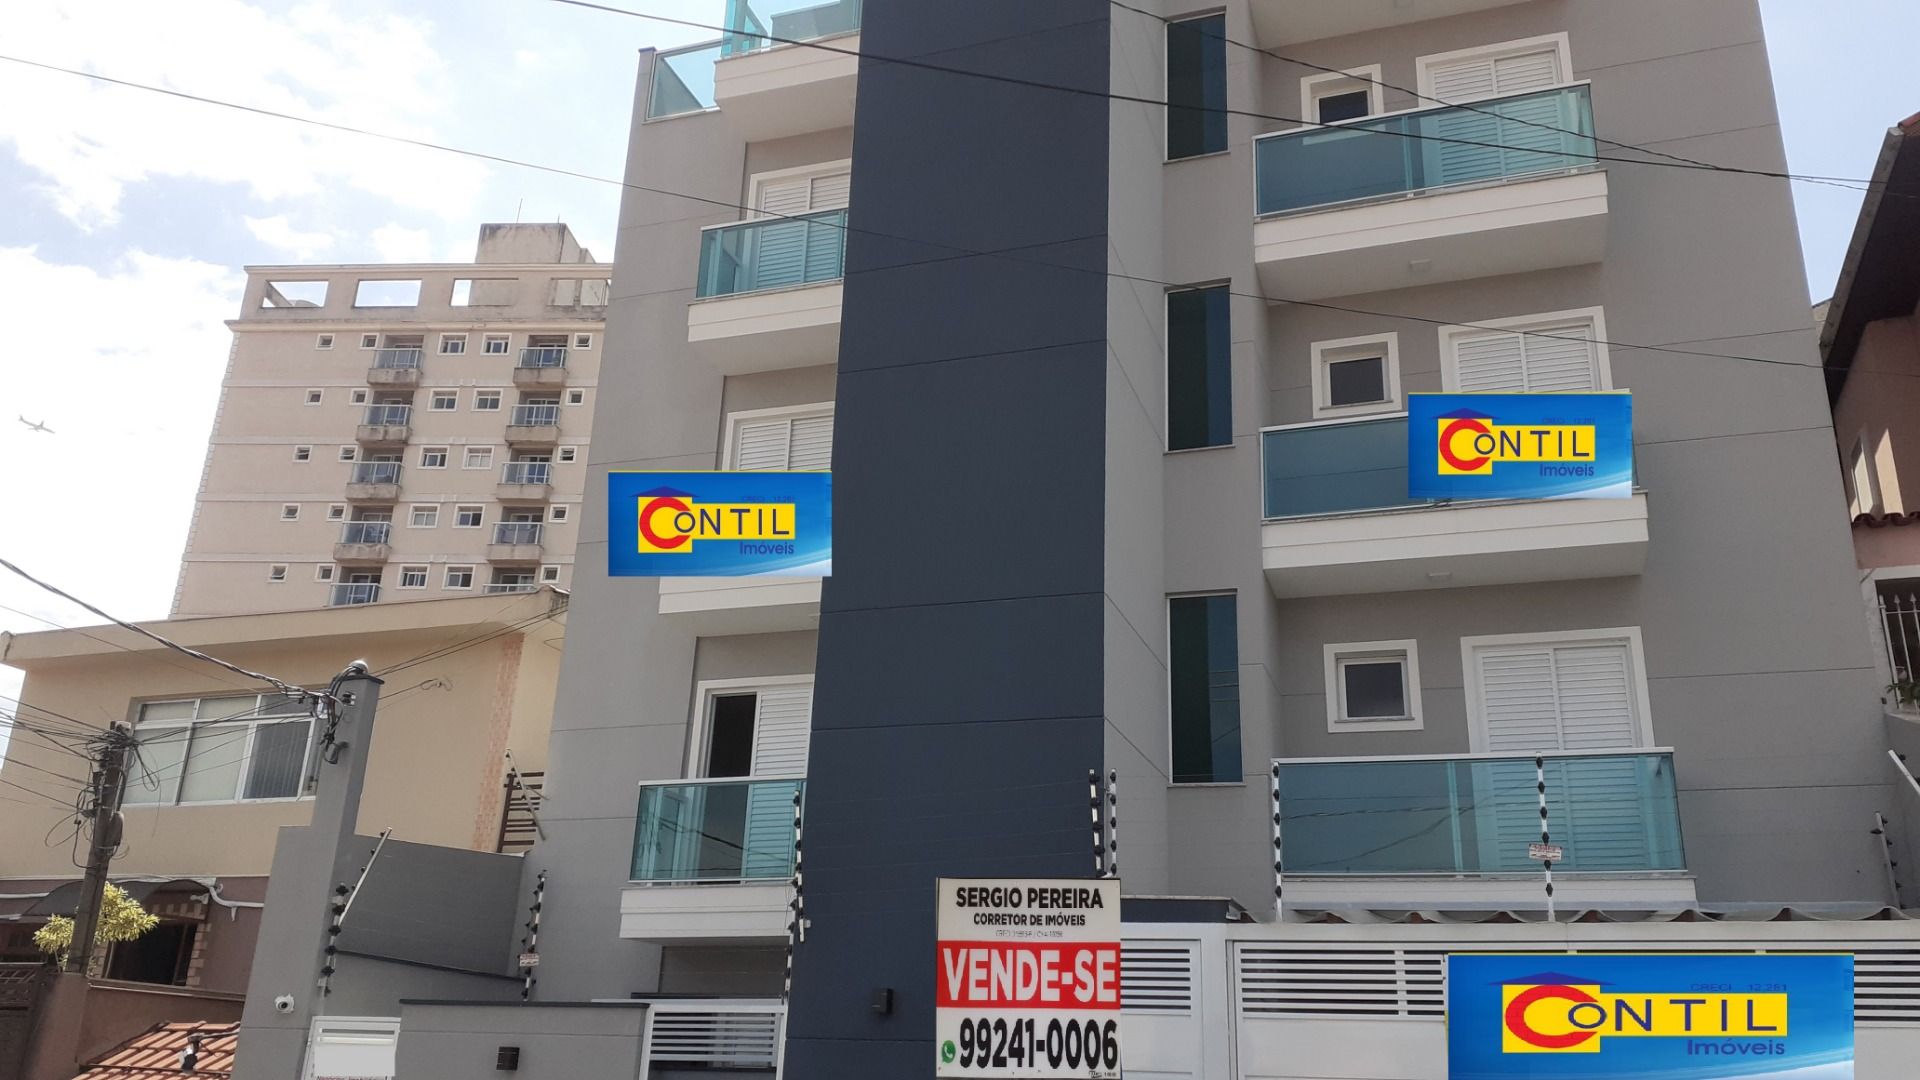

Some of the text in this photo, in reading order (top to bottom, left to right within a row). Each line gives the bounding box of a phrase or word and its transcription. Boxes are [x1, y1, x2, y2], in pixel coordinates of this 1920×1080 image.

[956, 887, 1104, 909] SERGIO PEREIRA
[974, 912, 1086, 926] CORRETOR DE IMÓVEIS
[943, 948, 1117, 1002] VENDE-SE
[960, 1018, 1118, 1069] 99241-0006
